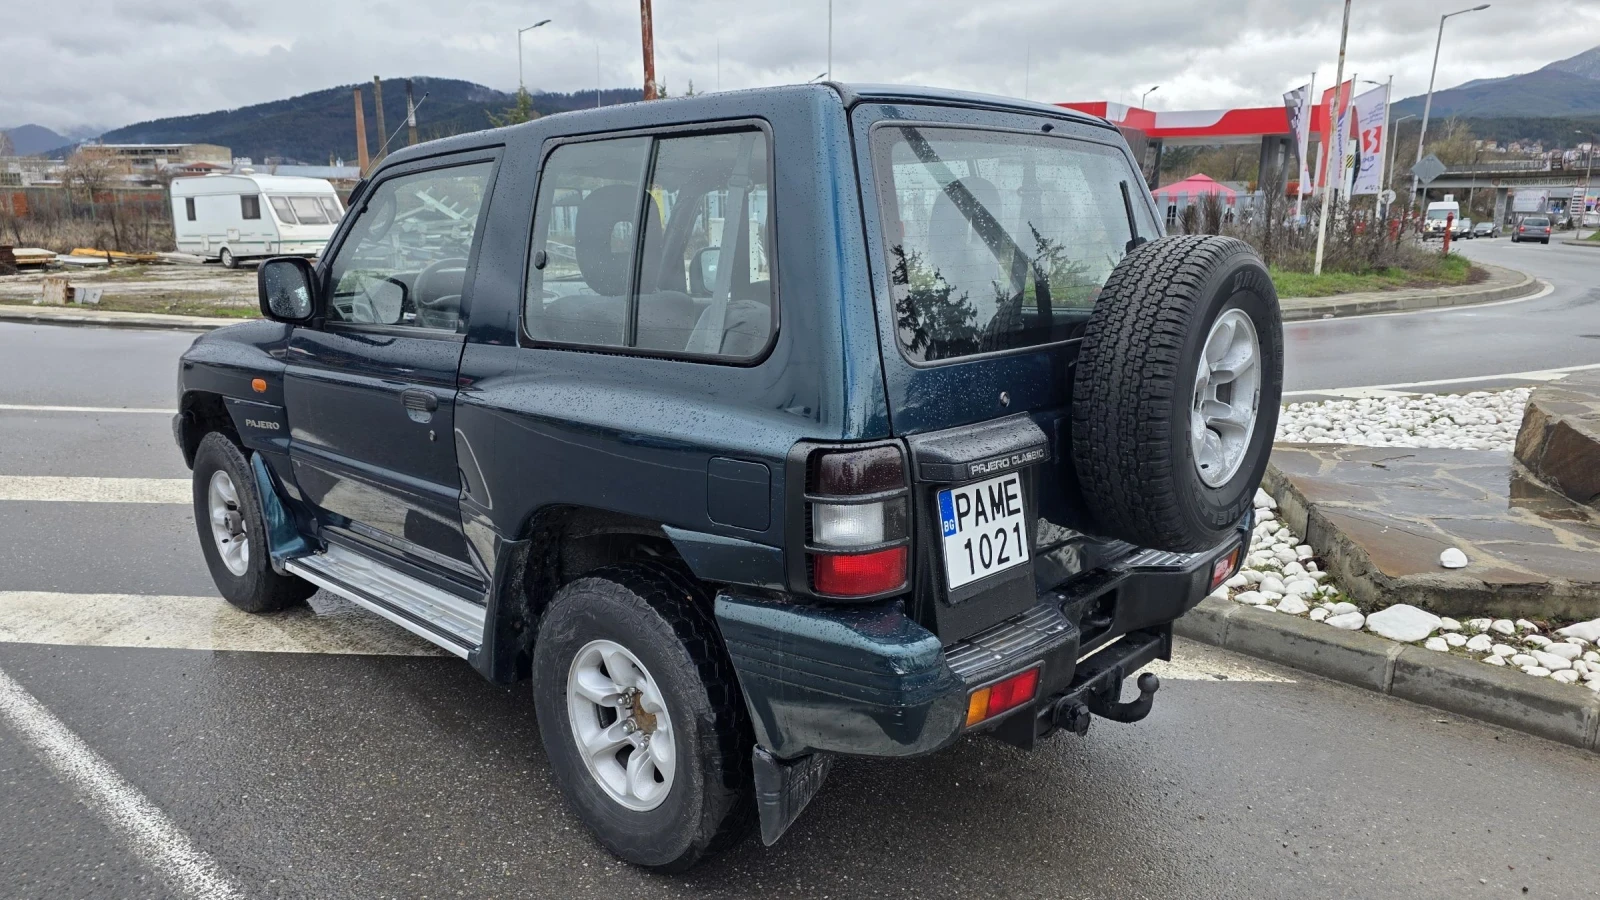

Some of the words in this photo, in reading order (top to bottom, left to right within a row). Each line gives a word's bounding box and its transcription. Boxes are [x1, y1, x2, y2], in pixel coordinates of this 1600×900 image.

[245, 418, 280, 430] PAJERO
[971, 458, 1010, 475] PAJERO
[1011, 448, 1044, 465] CLASSIC
[955, 478, 1021, 532] PAME
[944, 519, 955, 533] BG
[964, 521, 1023, 575] 1021
